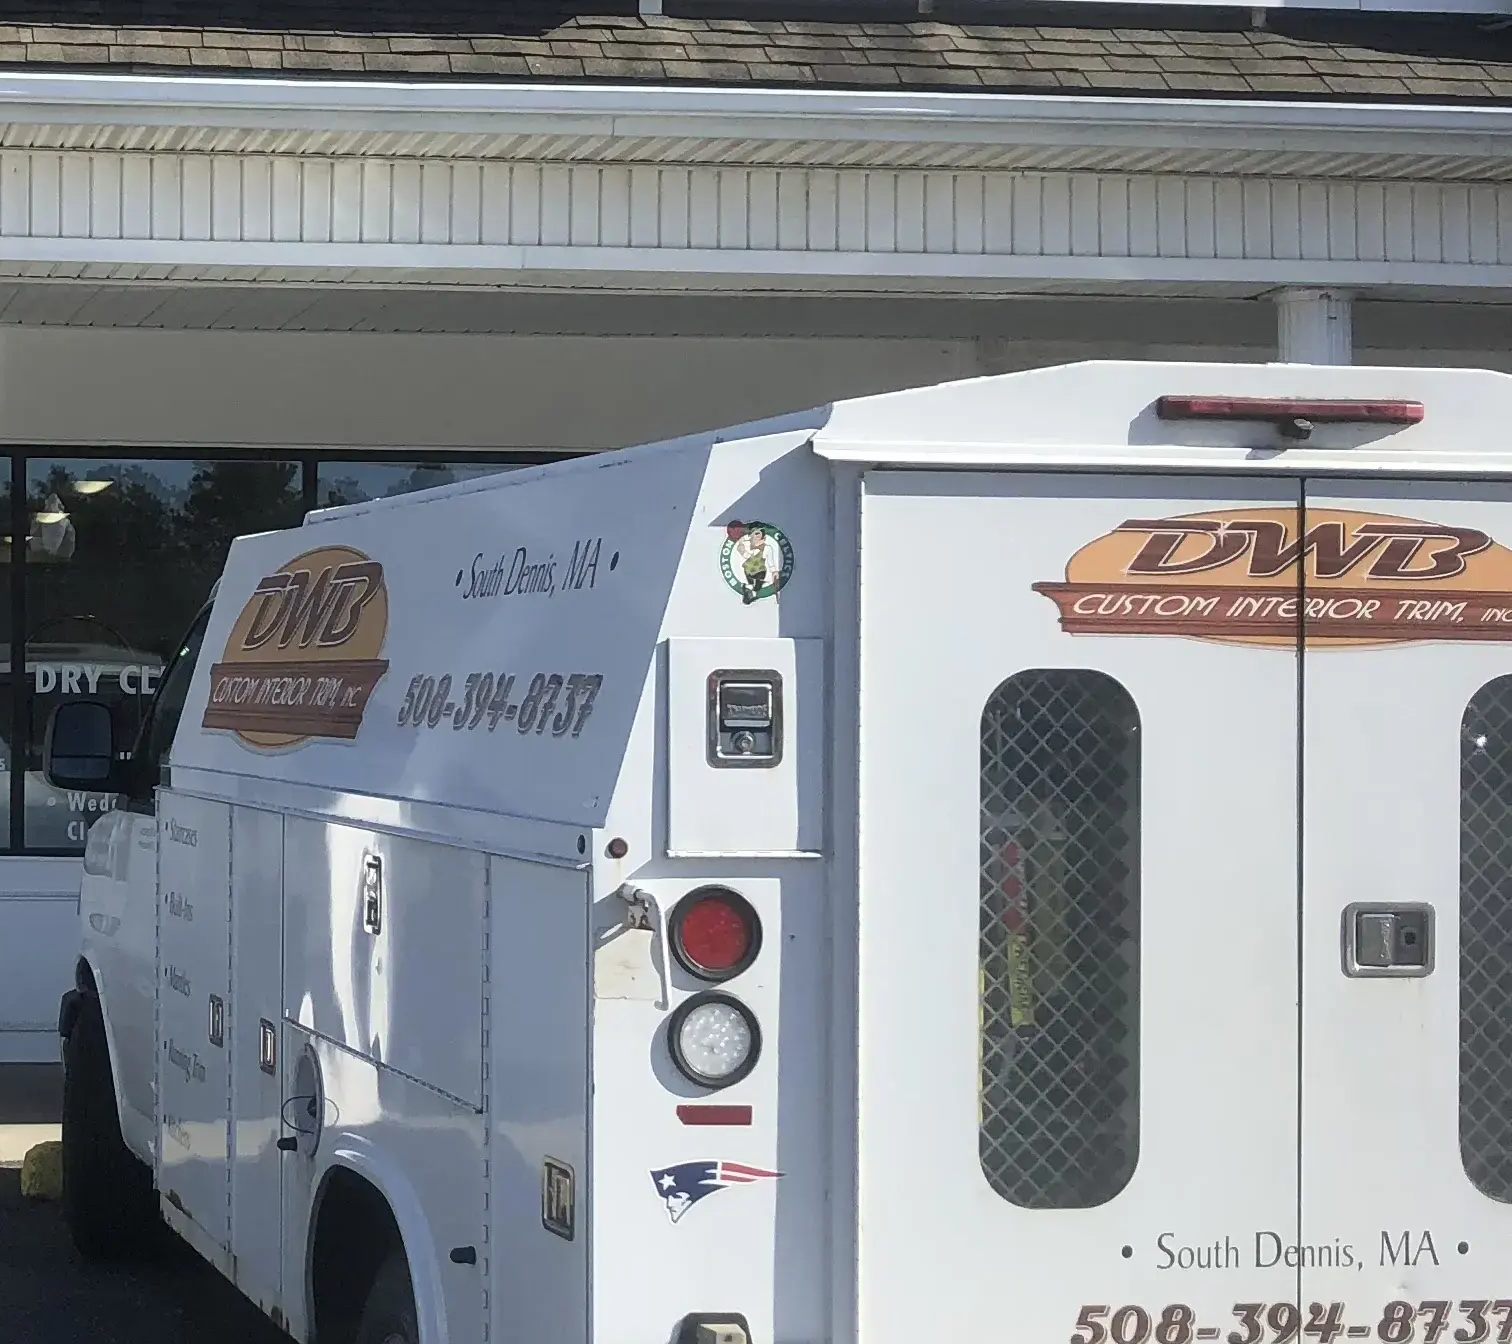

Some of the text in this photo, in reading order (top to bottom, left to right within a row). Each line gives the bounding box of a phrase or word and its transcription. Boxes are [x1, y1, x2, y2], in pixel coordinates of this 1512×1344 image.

[462, 537, 603, 600] South Dennis, MA
[722, 540, 737, 586] BOSTON
[1111, 518, 1493, 581] DWB
[240, 560, 384, 651] DWB
[1073, 593, 1221, 617] CUSTOM
[1226, 595, 1382, 620] INTERIOR
[1393, 599, 1469, 624] TRIM,
[35, 665, 166, 694] DRY CL
[213, 676, 260, 704] CUSTOM
[397, 672, 604, 739] 508-394-8737
[1156, 1230, 1440, 1272] South Dennis, MA
